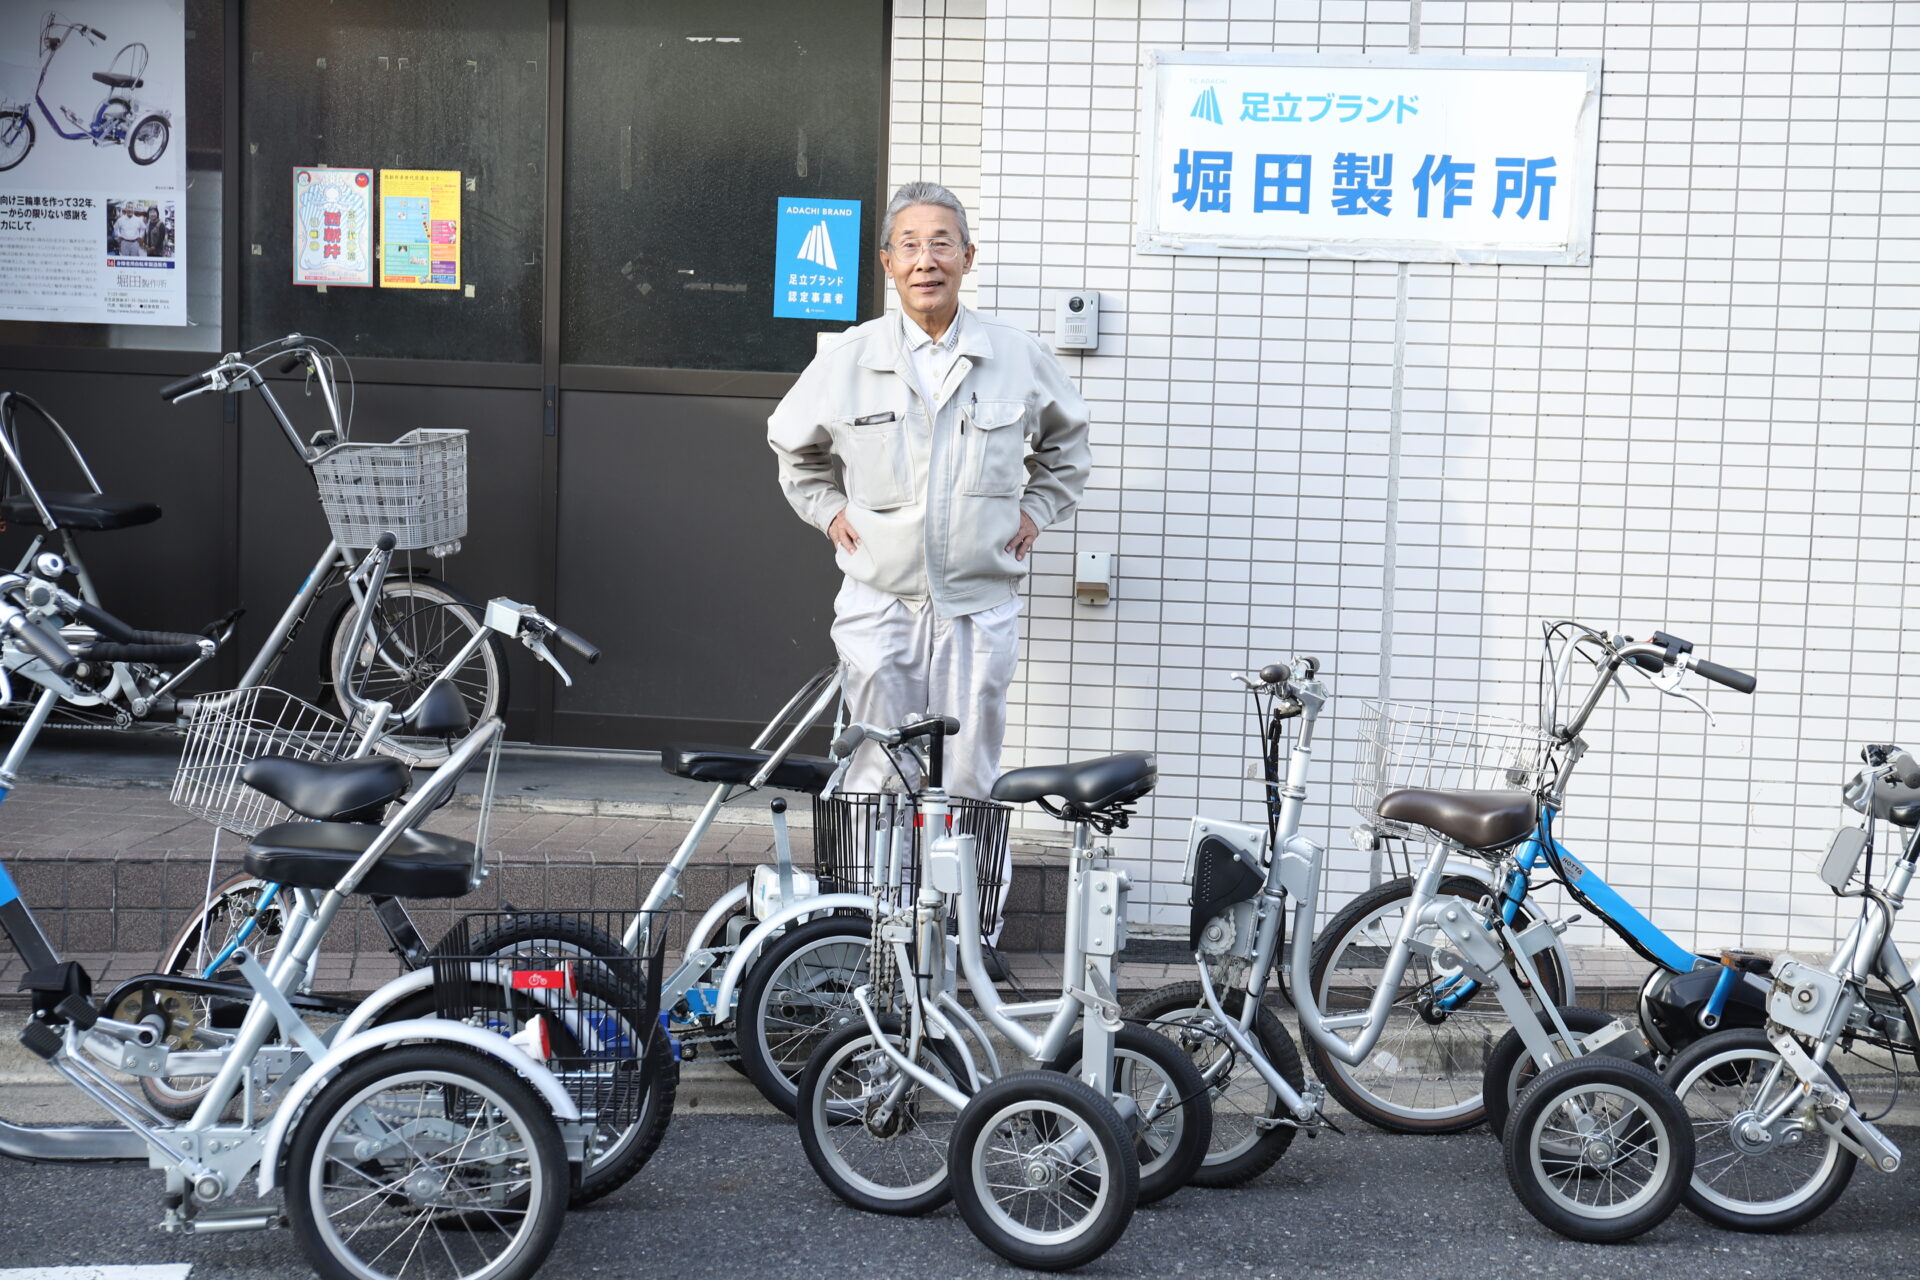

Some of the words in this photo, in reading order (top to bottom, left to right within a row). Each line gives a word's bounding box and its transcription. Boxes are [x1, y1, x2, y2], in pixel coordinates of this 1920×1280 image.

[1240, 91, 1419, 124] 足立ブランド
[1172, 148, 1558, 221] 堀田製作所
[786, 206, 820, 215] ADACHI
[822, 208, 852, 216] BRAND
[116, 274, 167, 289] 堀田製作所
[788, 273, 844, 287] 足立ブランド
[788, 291, 843, 304] 認定事業者
[1562, 857, 1582, 875] HOTTA
